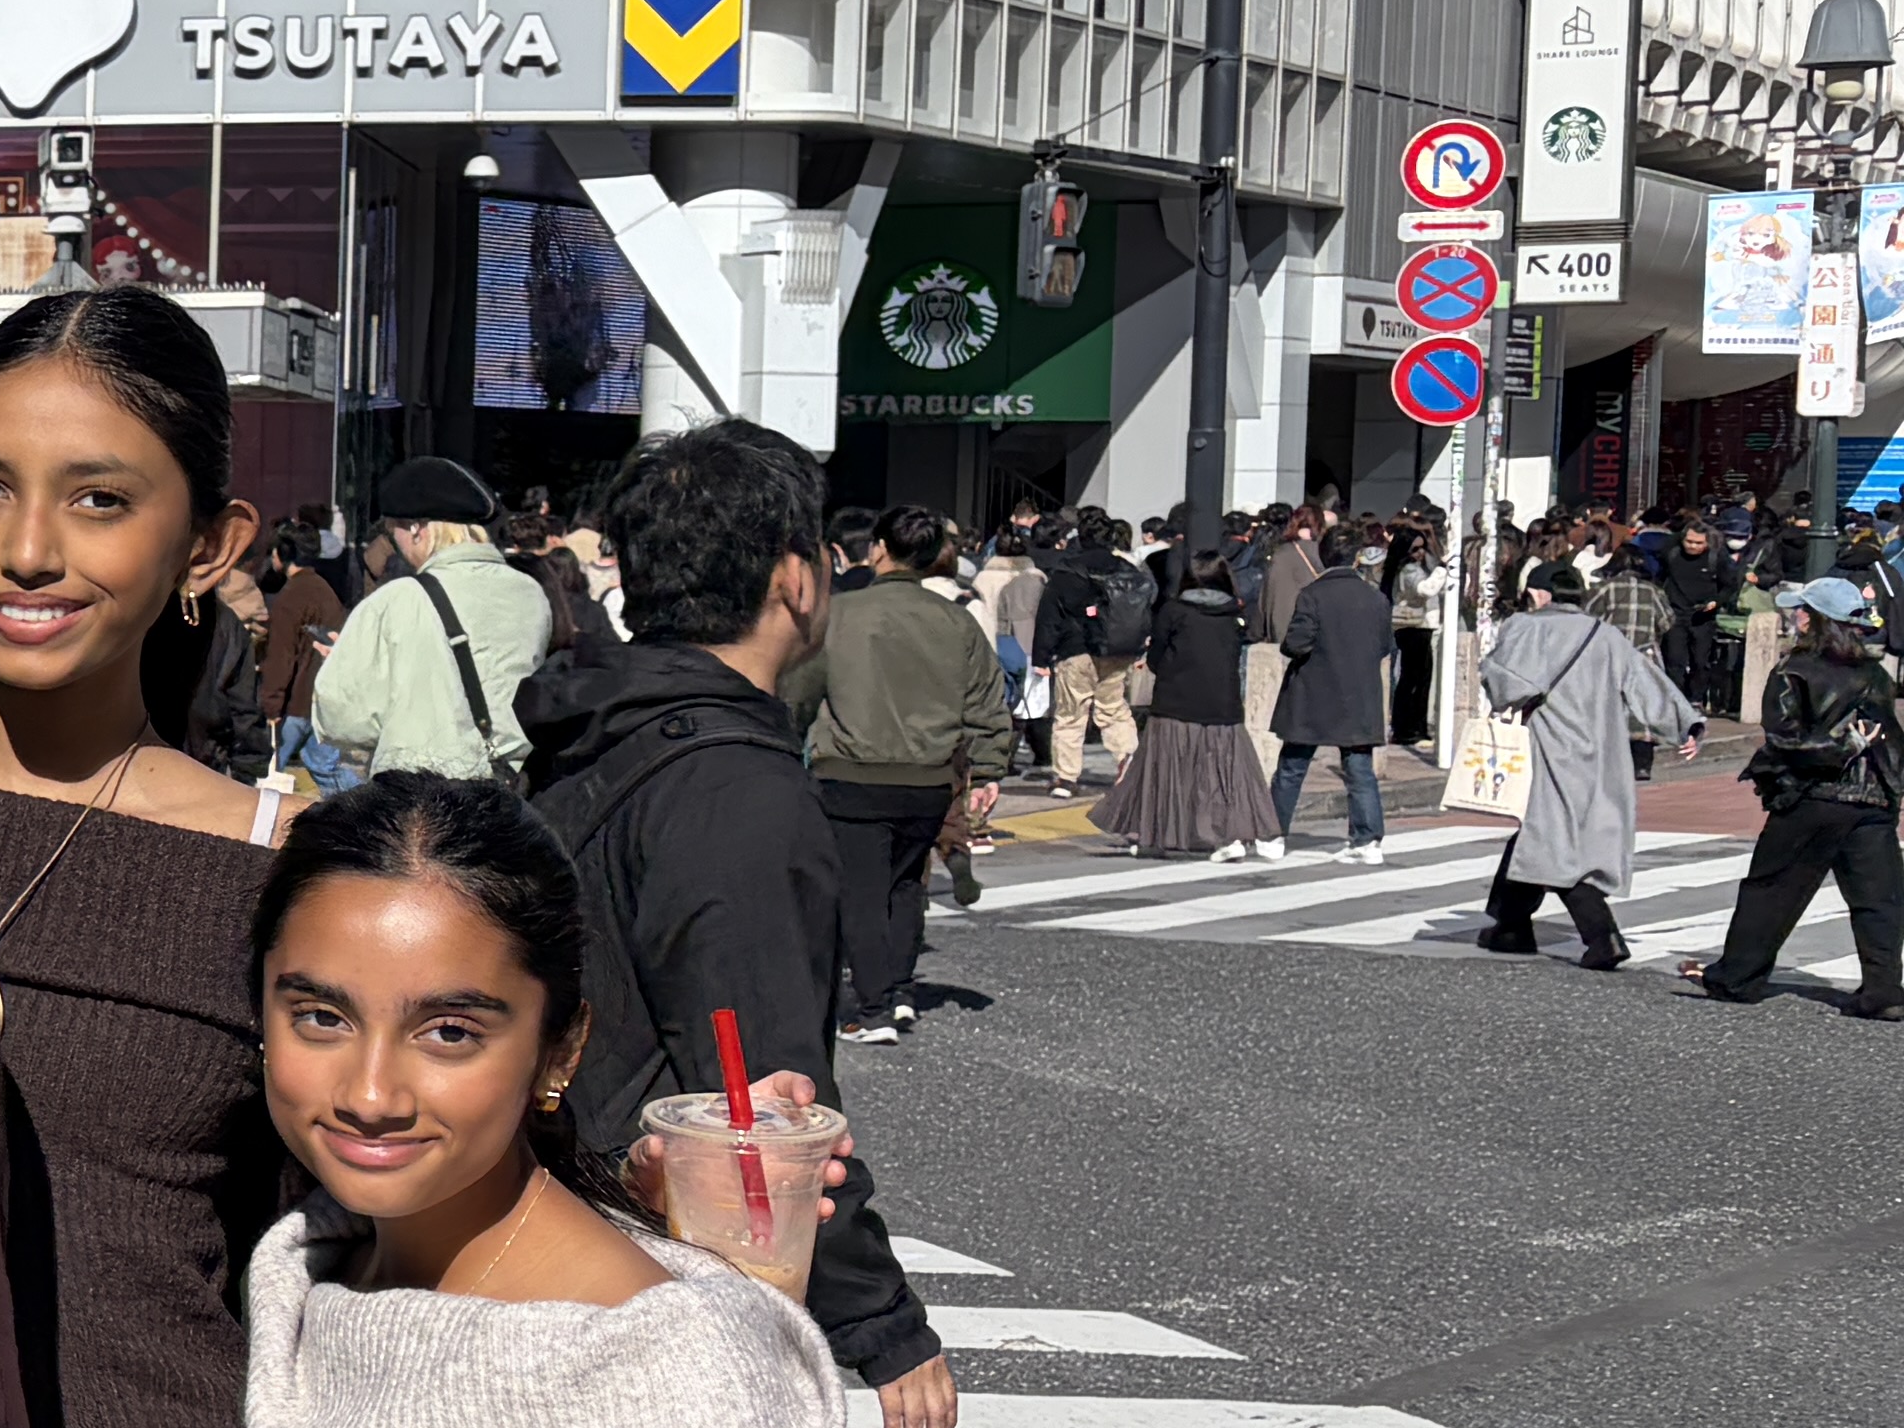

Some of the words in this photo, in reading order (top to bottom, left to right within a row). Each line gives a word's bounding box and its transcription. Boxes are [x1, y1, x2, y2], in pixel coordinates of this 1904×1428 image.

[181, 11, 561, 76] TSUTAYA
[1557, 253, 1612, 278] 400
[1558, 283, 1610, 293] SEATS
[1807, 267, 1839, 402] 公園通り
[840, 394, 1034, 416] STARBUCKS
